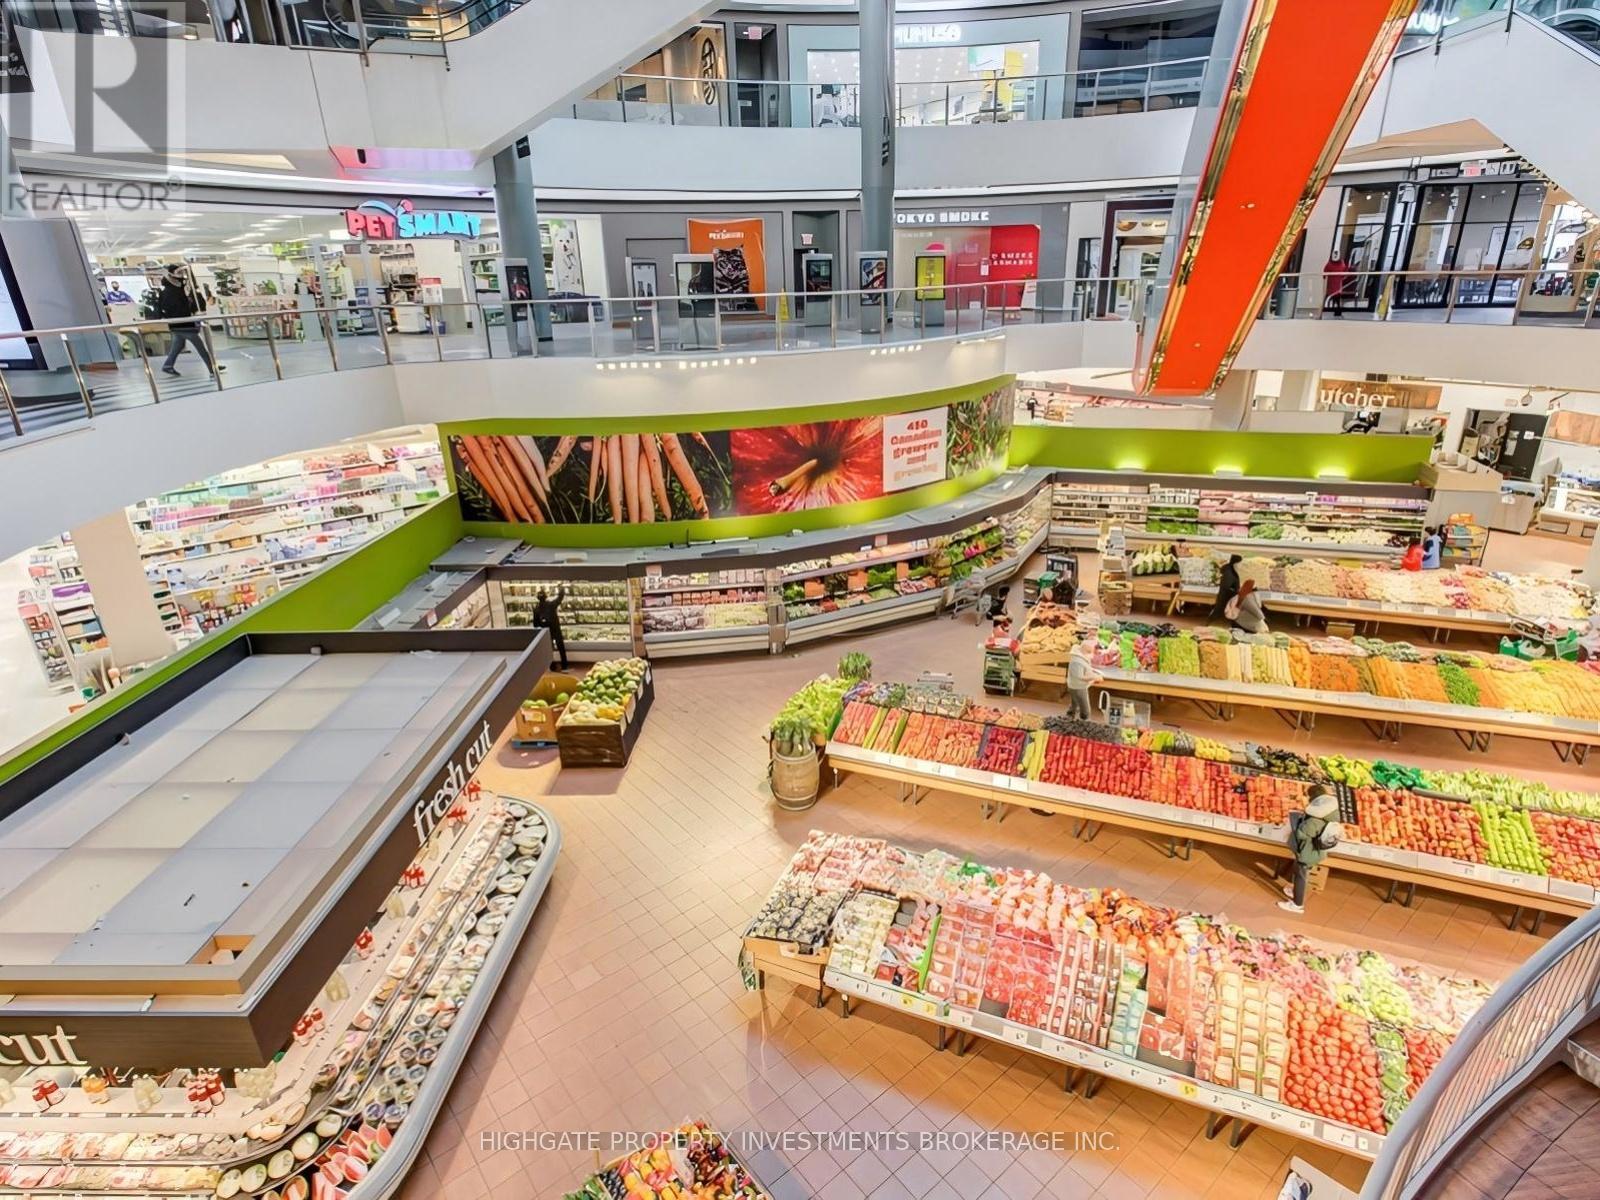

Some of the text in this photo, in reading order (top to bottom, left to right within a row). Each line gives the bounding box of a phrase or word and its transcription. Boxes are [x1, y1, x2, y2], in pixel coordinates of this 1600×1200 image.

[894, 213, 935, 223] OKYO
[1320, 387, 1395, 408] utcher
[413, 720, 493, 844] fresh cut
[0, 1025, 88, 1065] cut
